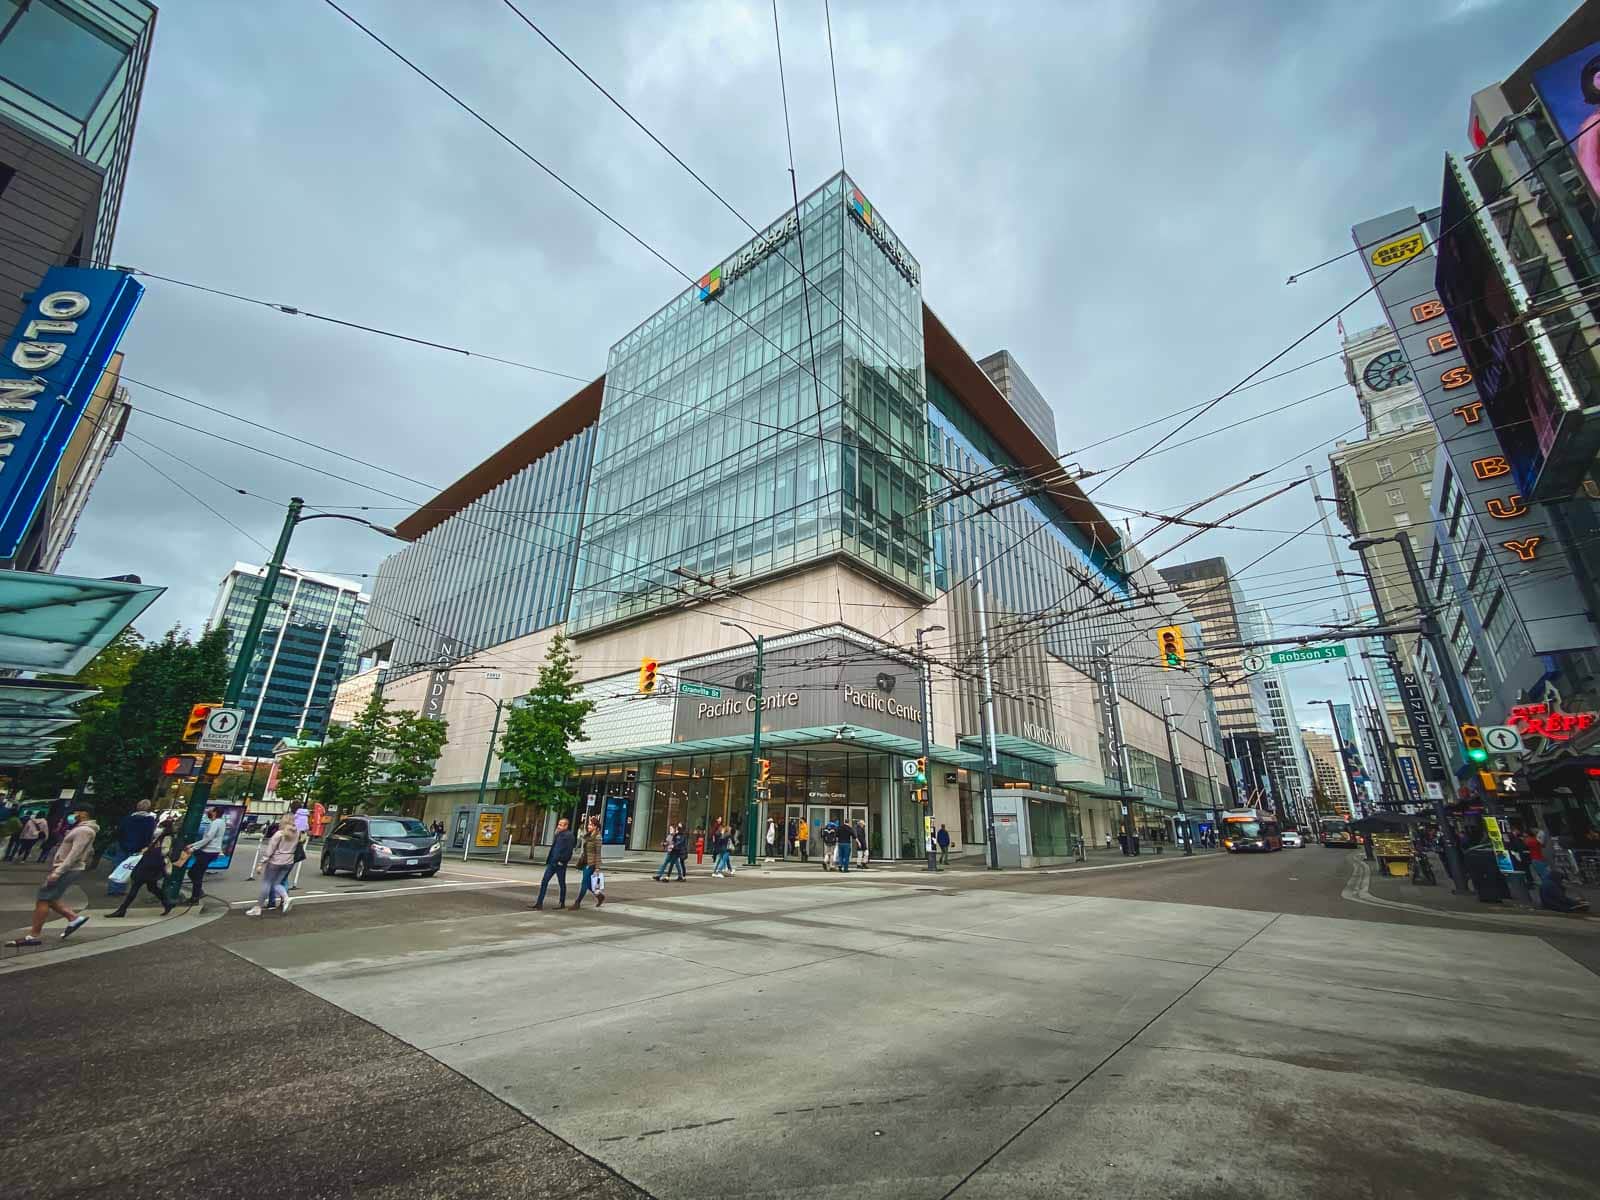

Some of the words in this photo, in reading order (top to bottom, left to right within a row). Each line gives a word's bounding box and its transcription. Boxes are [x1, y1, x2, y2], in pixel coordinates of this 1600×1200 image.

[722, 214, 799, 281] Microsoft
[1378, 238, 1420, 258] BEST
[1381, 246, 1416, 263] BUY
[12, 290, 91, 371] OLD
[1410, 299, 1483, 426] BEST
[1471, 455, 1544, 562] BUY
[1279, 649, 1321, 663] Robson
[1324, 648, 1337, 658] St
[698, 698, 742, 720] Pacific
[745, 690, 800, 713] Centre
[844, 683, 885, 713] Pacific
[887, 698, 923, 724] Centre
